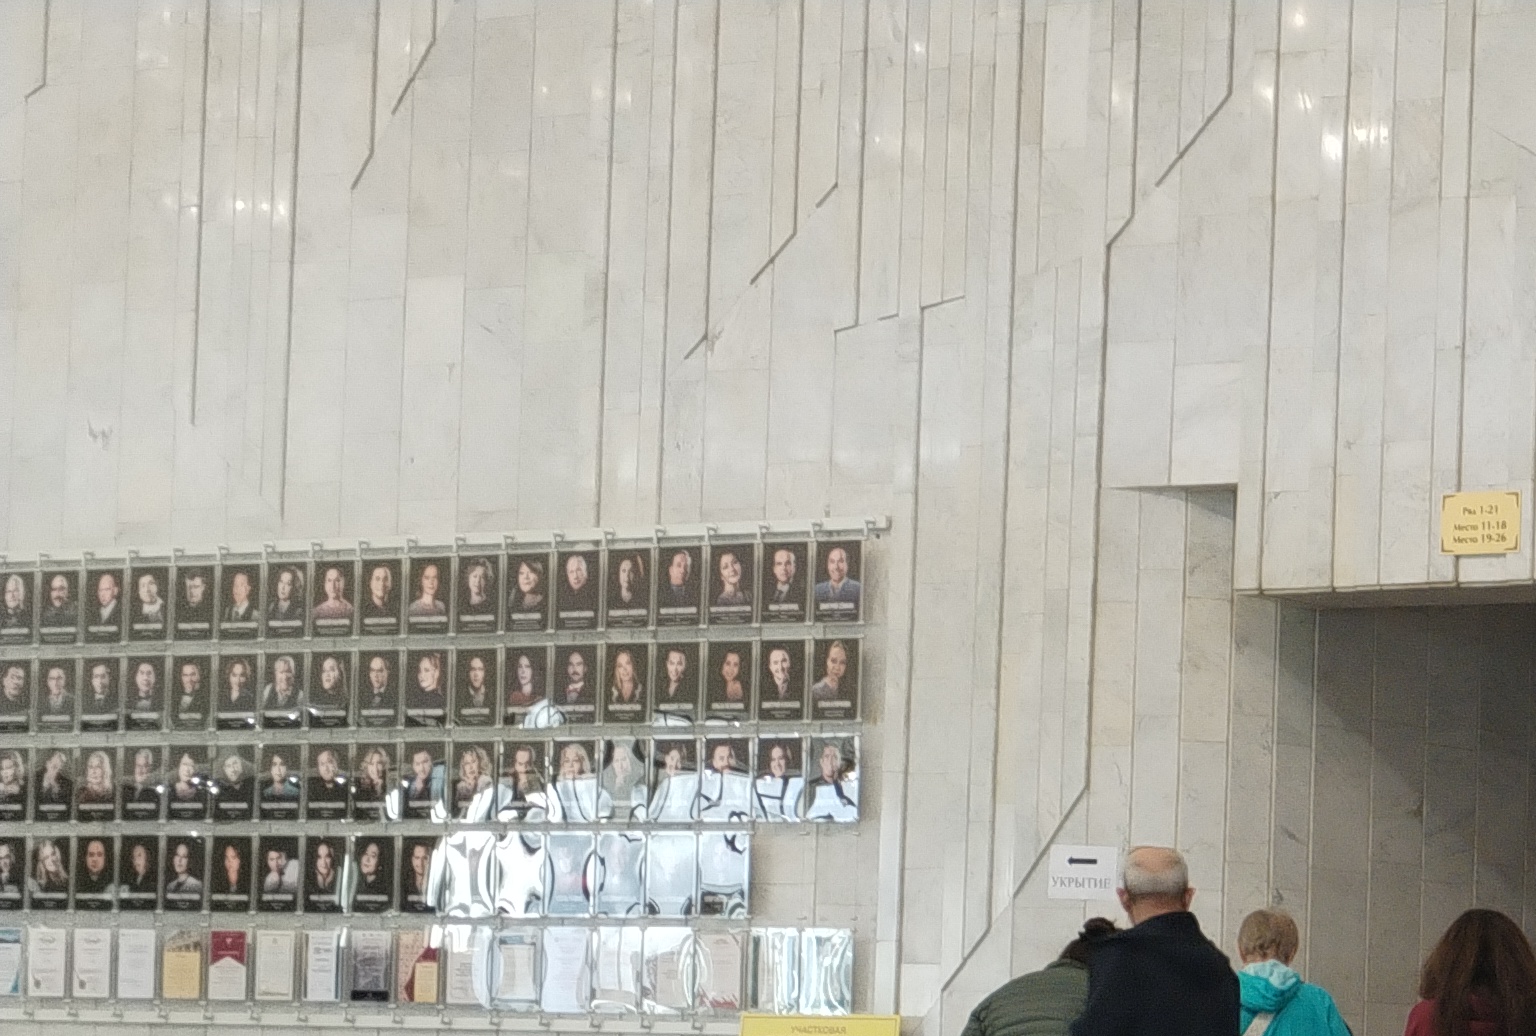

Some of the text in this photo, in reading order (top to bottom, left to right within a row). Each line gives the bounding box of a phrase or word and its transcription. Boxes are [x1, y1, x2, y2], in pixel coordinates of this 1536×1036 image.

[1480, 505, 1498, 514] 1-21
[1481, 520, 1507, 530] 11-18
[1453, 534, 1506, 544] Место 19-26
[1052, 876, 1111, 889] УКРЫТИЕ
